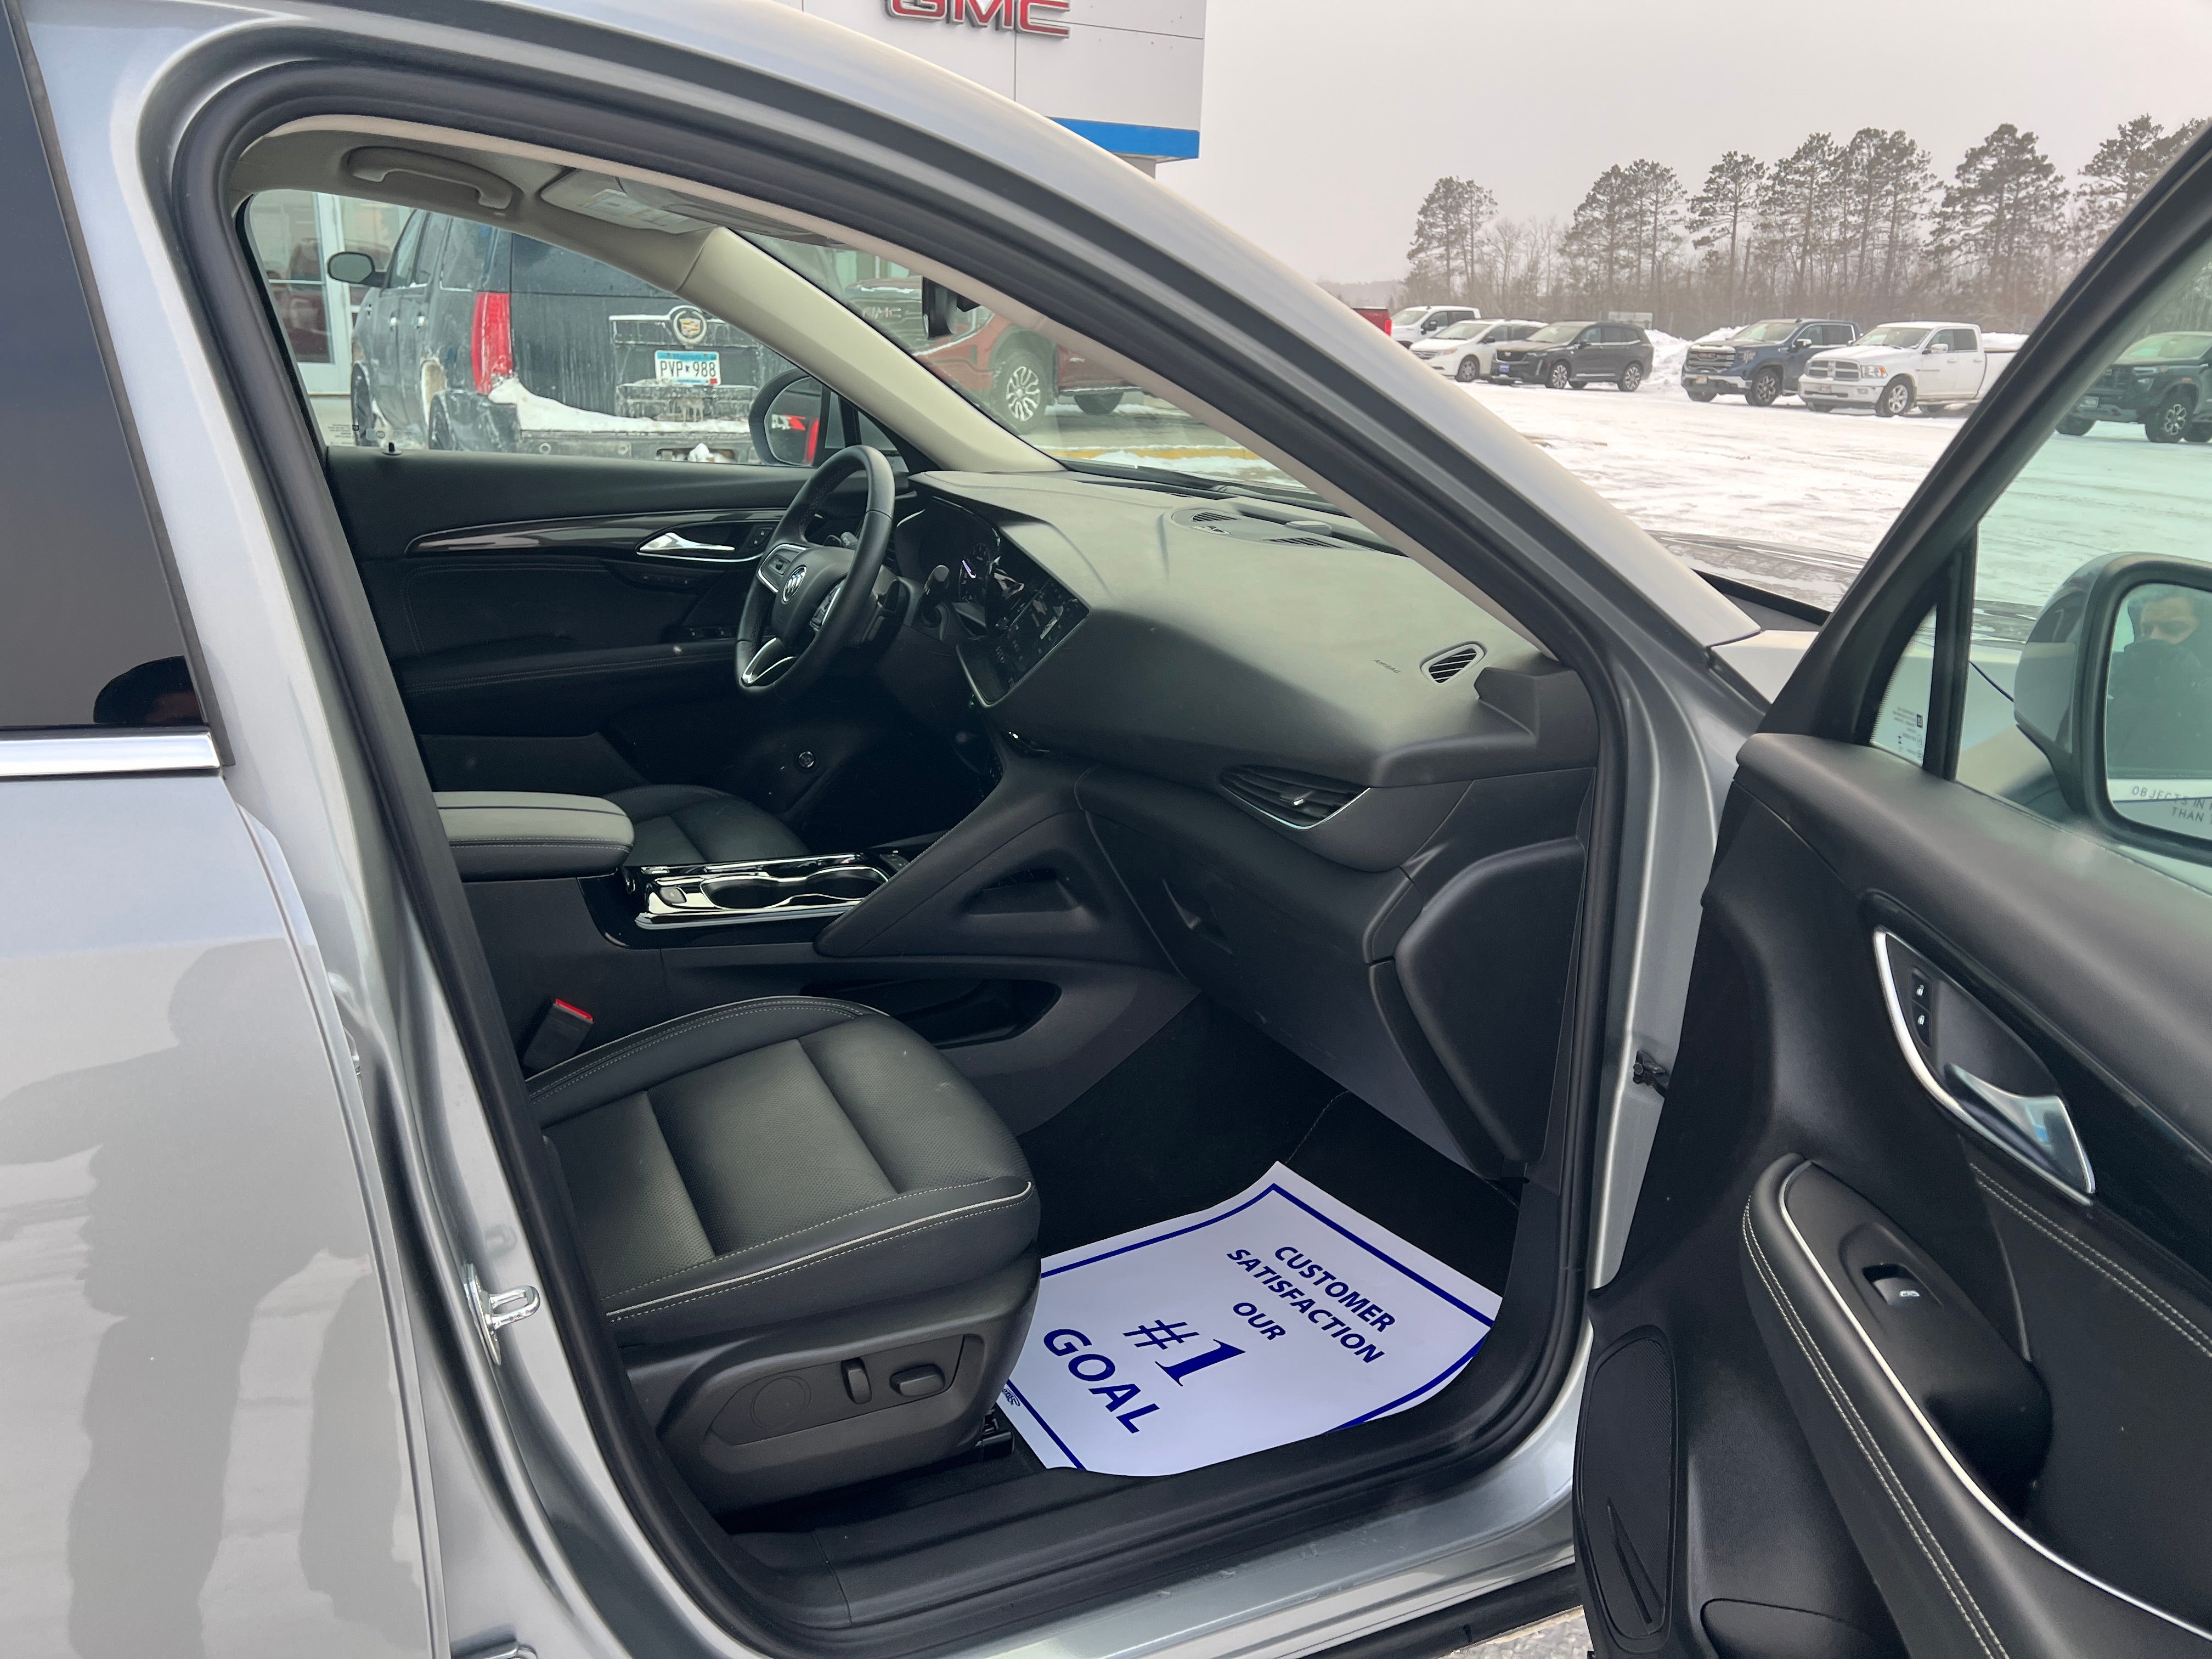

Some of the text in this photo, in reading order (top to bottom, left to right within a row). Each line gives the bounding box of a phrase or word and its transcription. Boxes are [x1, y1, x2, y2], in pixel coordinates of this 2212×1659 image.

[693, 361, 716, 377] 988
[1373, 659, 1401, 674] AIRBAG
[2132, 786, 2190, 805] OBJECTS
[2193, 797, 2205, 809] IN
[2172, 806, 2204, 822] THAN
[1226, 1248, 1386, 1364] SATISFACTION
[1275, 1246, 1396, 1333] CUSTOMER
[1232, 1301, 1286, 1342] OUR
[1122, 1319, 1246, 1387] #1
[1043, 1328, 1161, 1434] GOAL
